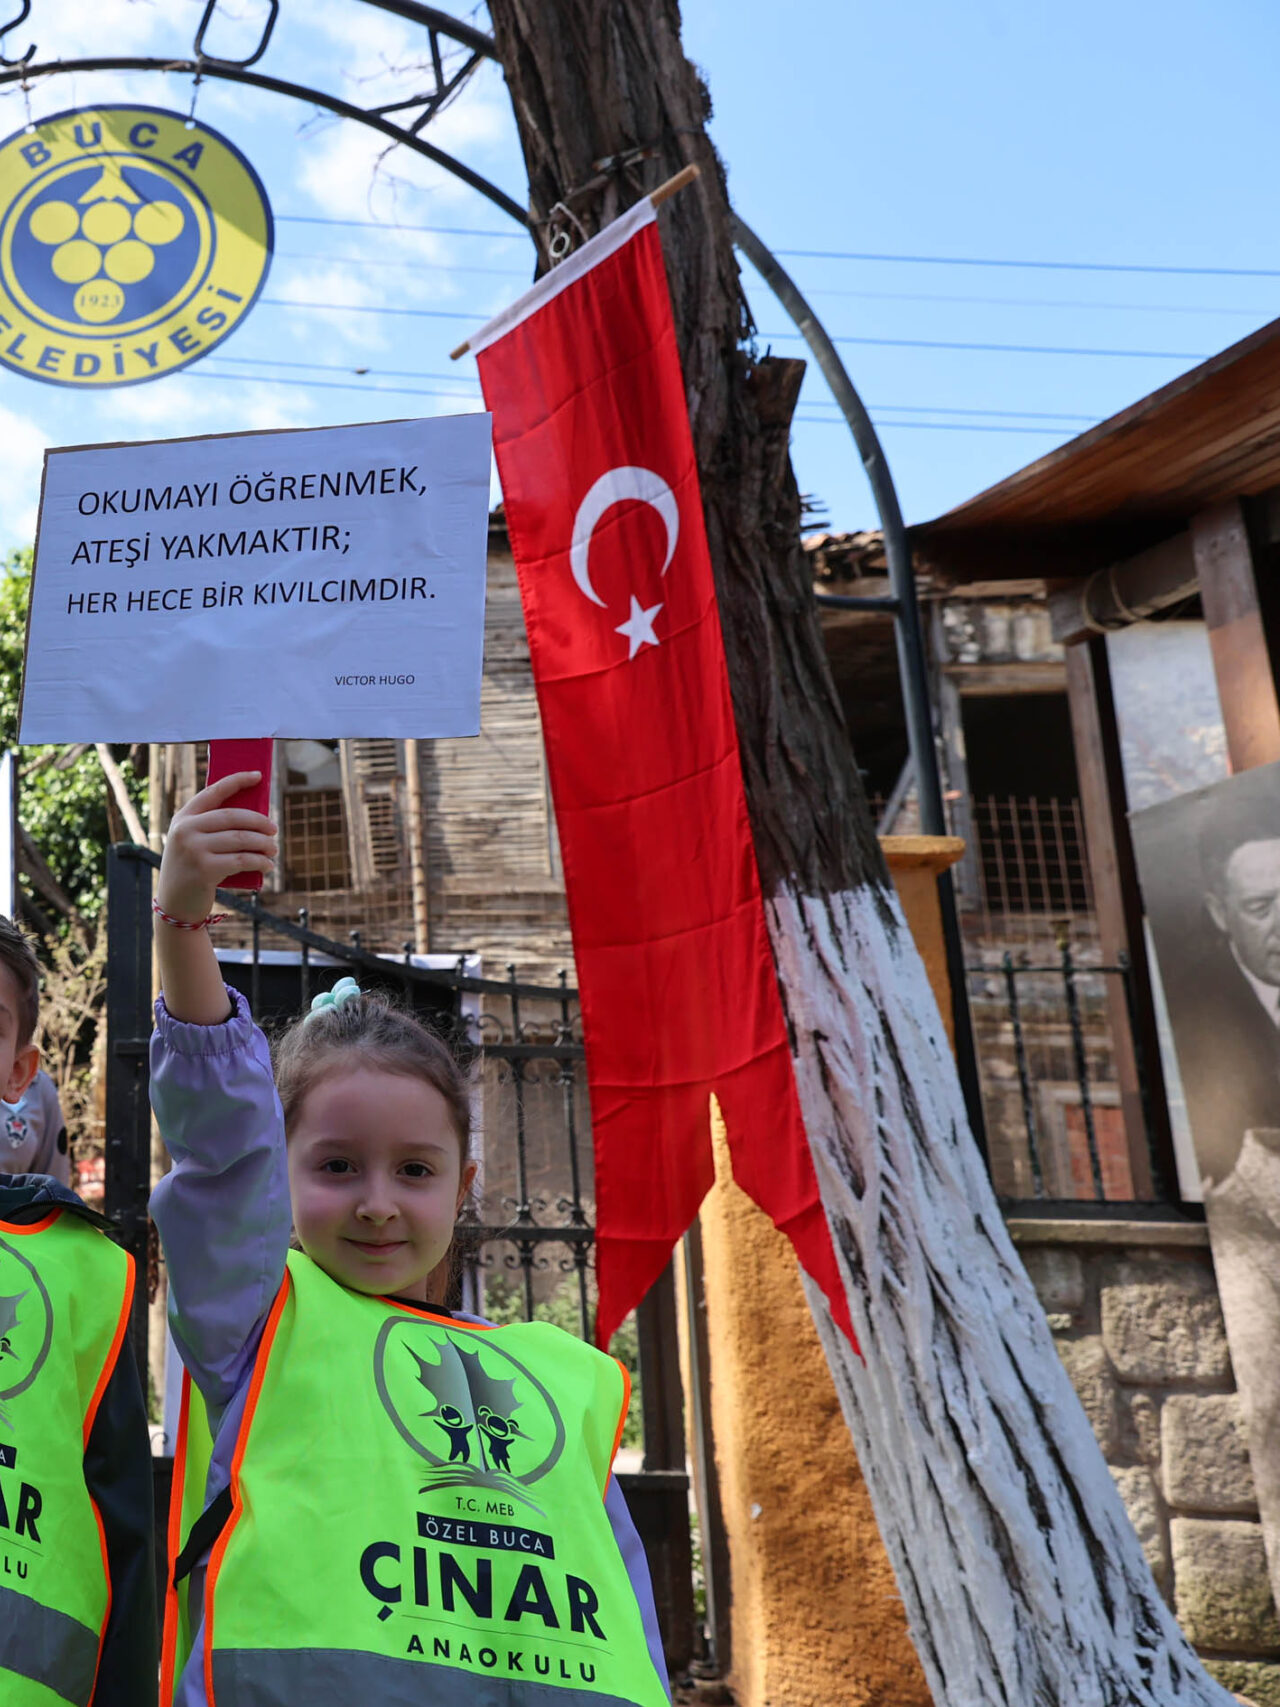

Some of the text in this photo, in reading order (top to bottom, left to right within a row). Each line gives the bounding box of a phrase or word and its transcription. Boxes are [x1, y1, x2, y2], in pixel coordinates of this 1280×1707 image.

[19, 121, 205, 171] BUCA
[77, 465, 428, 516] OKUMAYI ÖĞRENMEK,
[71, 525, 351, 569] ATEŞİ YAKMAKTIR;
[66, 576, 437, 615] HER HECE BİR KIVILCIMDIR.
[334, 674, 415, 686] VICTOR HUGO
[455, 1497, 515, 1517] T.C. MEB
[425, 1516, 545, 1554] ÖZEL BUCA
[359, 1540, 608, 1641] ÇINAR
[407, 1633, 596, 1683] ANAOKULU
